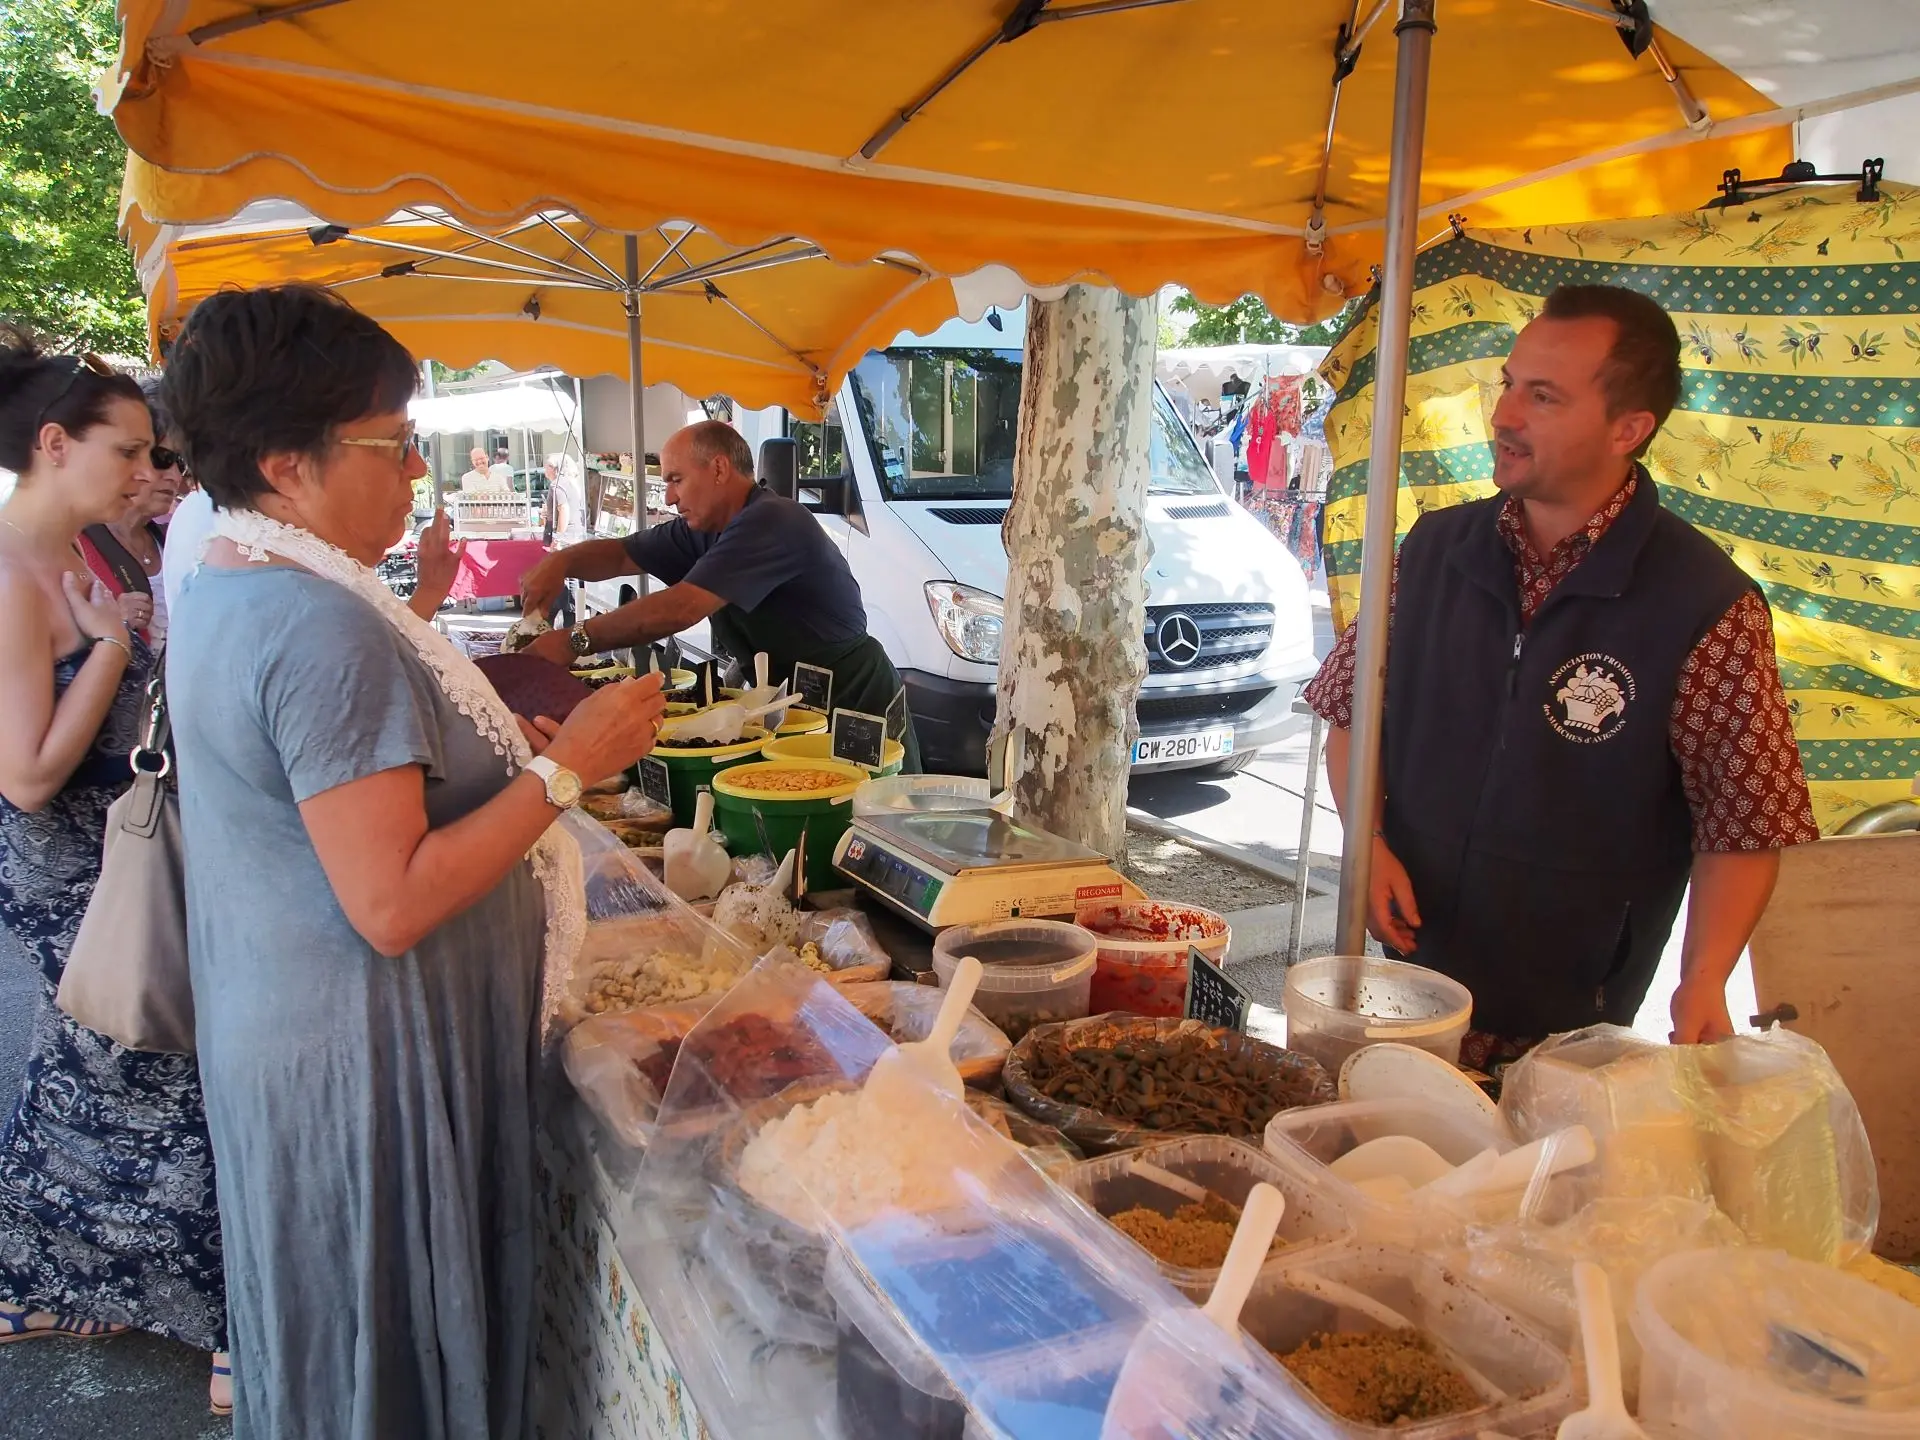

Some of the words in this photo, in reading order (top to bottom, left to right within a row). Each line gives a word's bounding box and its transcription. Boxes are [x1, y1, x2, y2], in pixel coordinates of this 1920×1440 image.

[1548, 653, 1602, 687] ASSOCIATION
[1603, 655, 1636, 700] PROMOTION
[1584, 719, 1627, 744] d'AVIGNON
[1138, 734, 1222, 760] CW-280-VJ
[1078, 886, 1120, 898] FREGONARA
